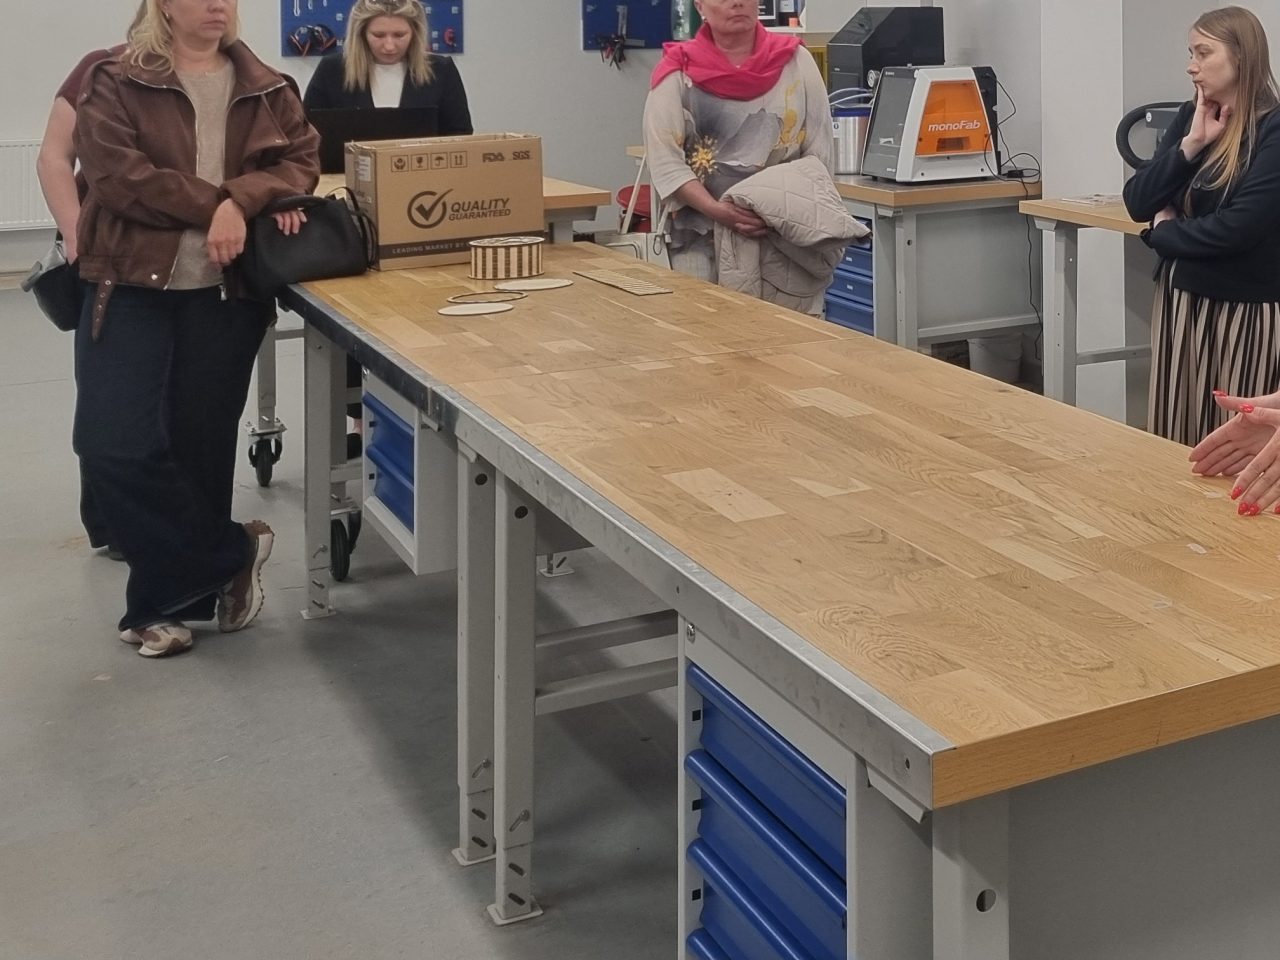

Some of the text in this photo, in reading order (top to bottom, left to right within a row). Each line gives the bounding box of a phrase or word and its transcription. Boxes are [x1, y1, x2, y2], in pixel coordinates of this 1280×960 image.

[928, 120, 981, 132] monoFab
[512, 150, 531, 161] SGS
[451, 198, 510, 214] QUALITY
[448, 208, 512, 221] GUARANTEED
[392, 246, 424, 254] LEADING
